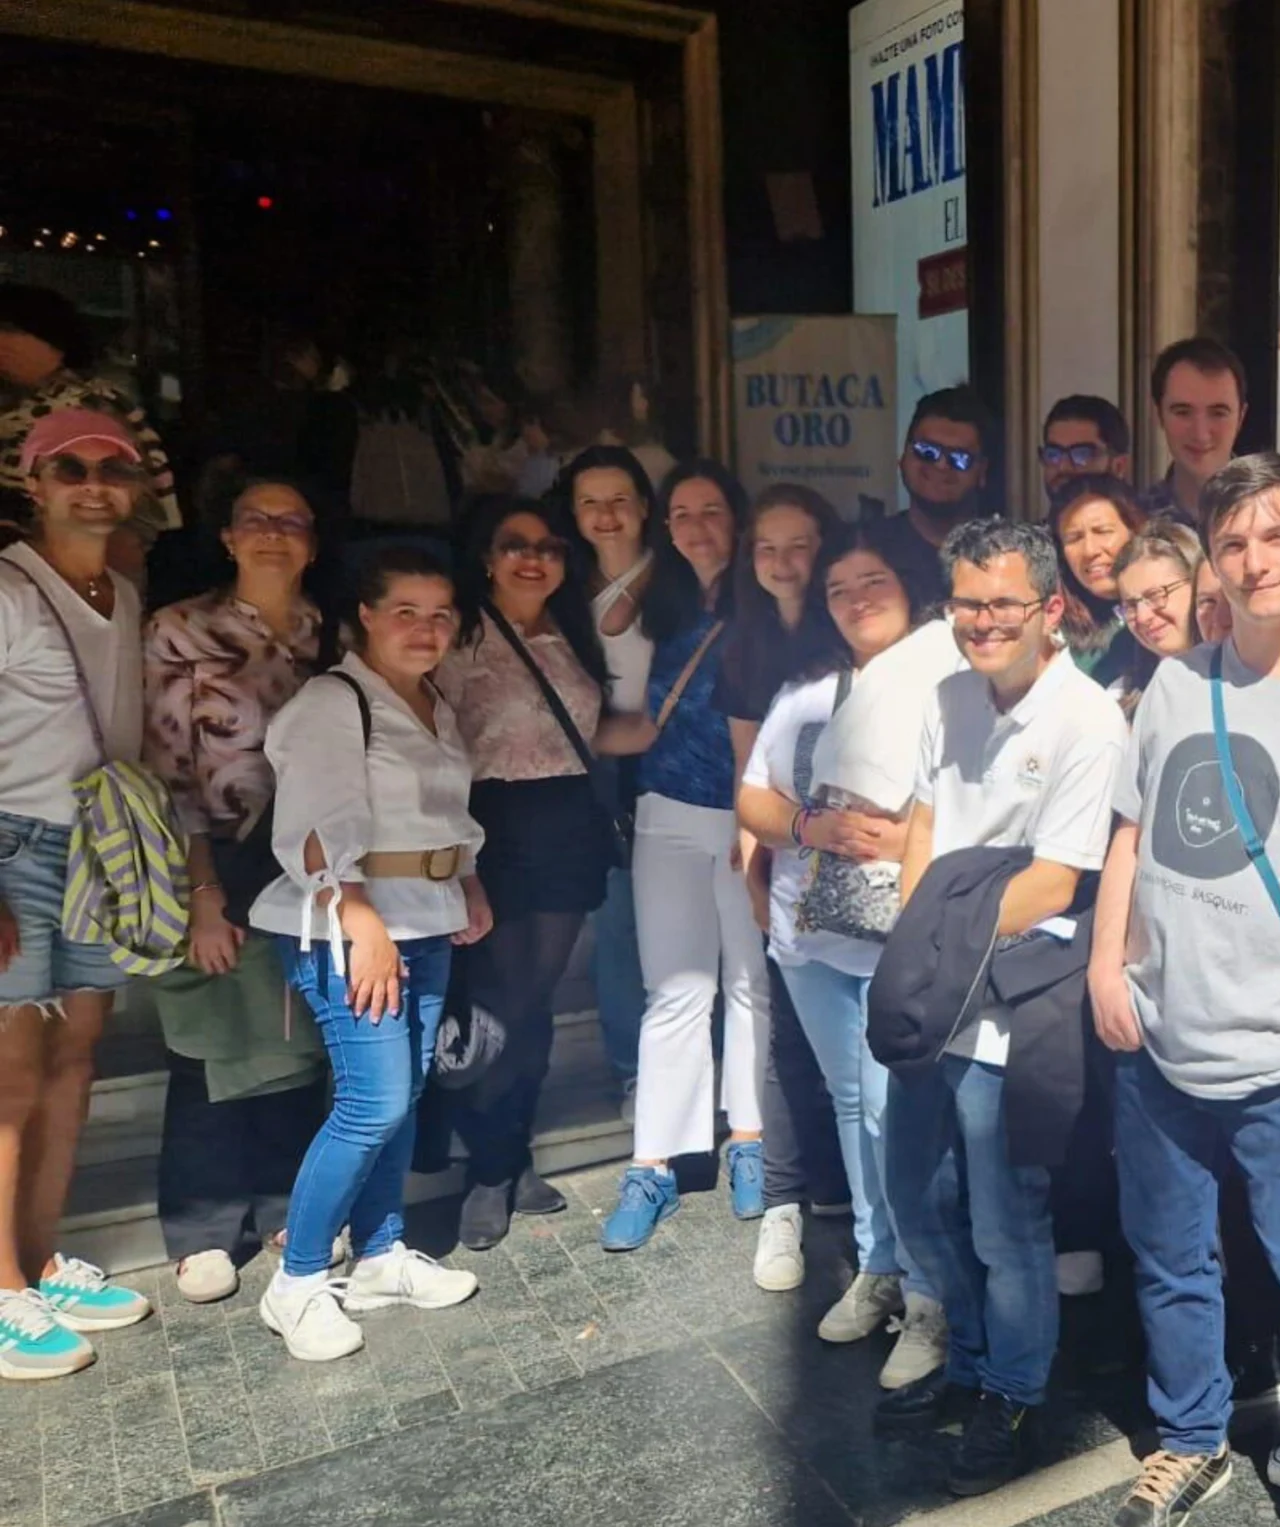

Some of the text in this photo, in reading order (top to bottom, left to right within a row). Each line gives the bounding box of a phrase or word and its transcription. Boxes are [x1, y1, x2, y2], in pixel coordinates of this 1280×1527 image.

[870, 40, 966, 208] MAM
[745, 372, 885, 410] BUTACA
[773, 411, 852, 448] ORO
